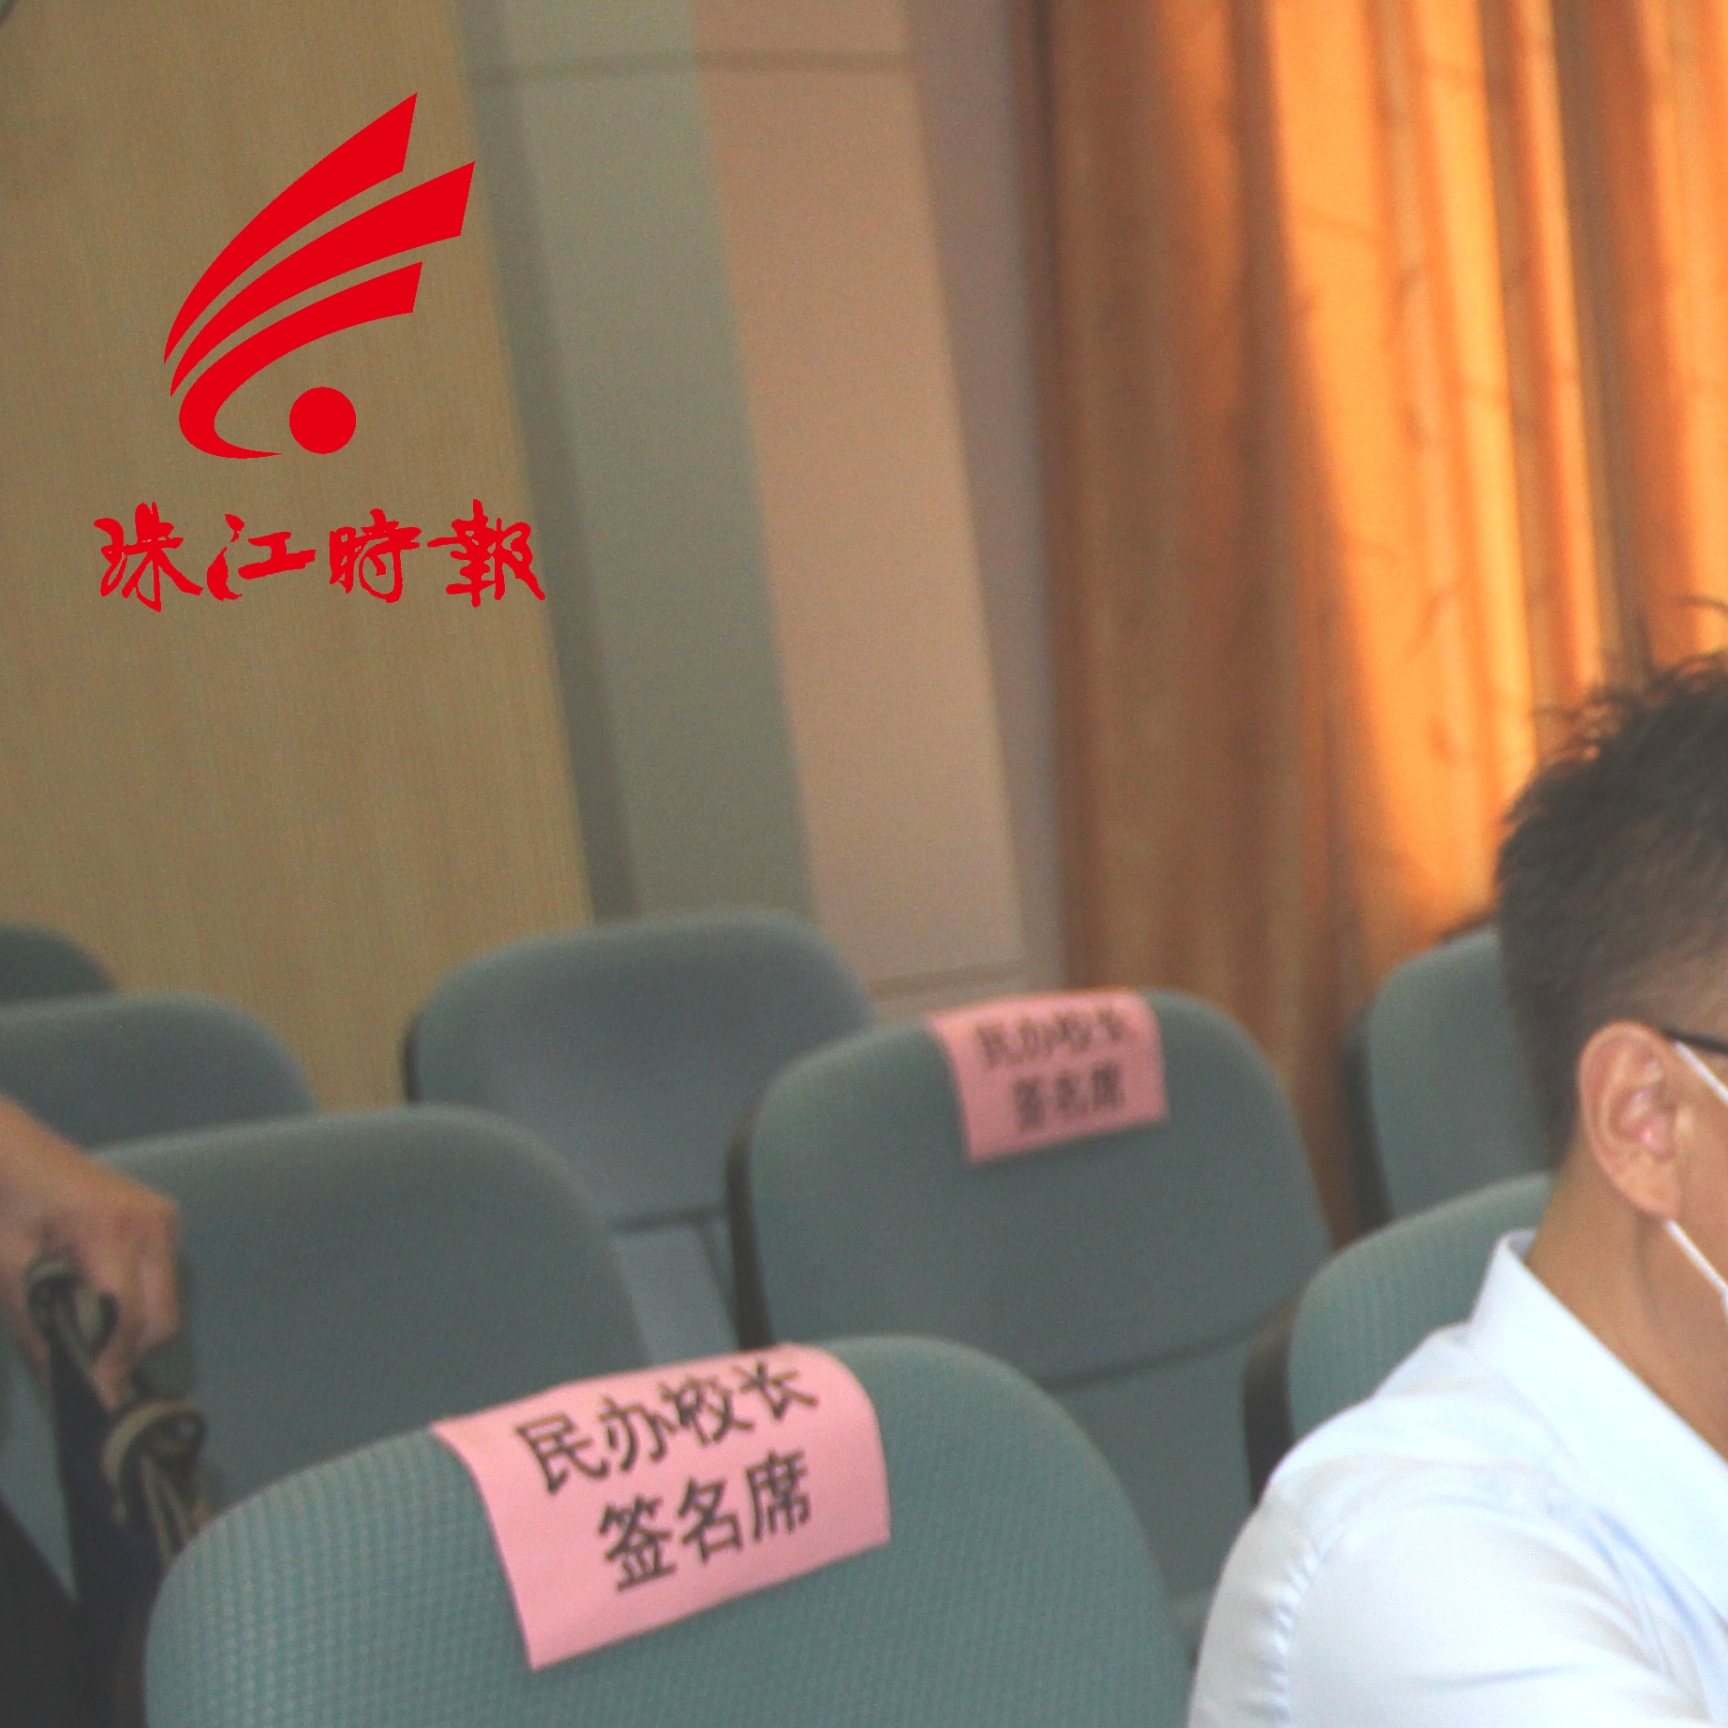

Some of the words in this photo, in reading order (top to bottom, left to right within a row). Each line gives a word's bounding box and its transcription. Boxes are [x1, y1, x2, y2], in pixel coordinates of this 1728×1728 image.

[514, 1360, 818, 1495] 民办校长
[598, 1449, 812, 1593] 签名席
